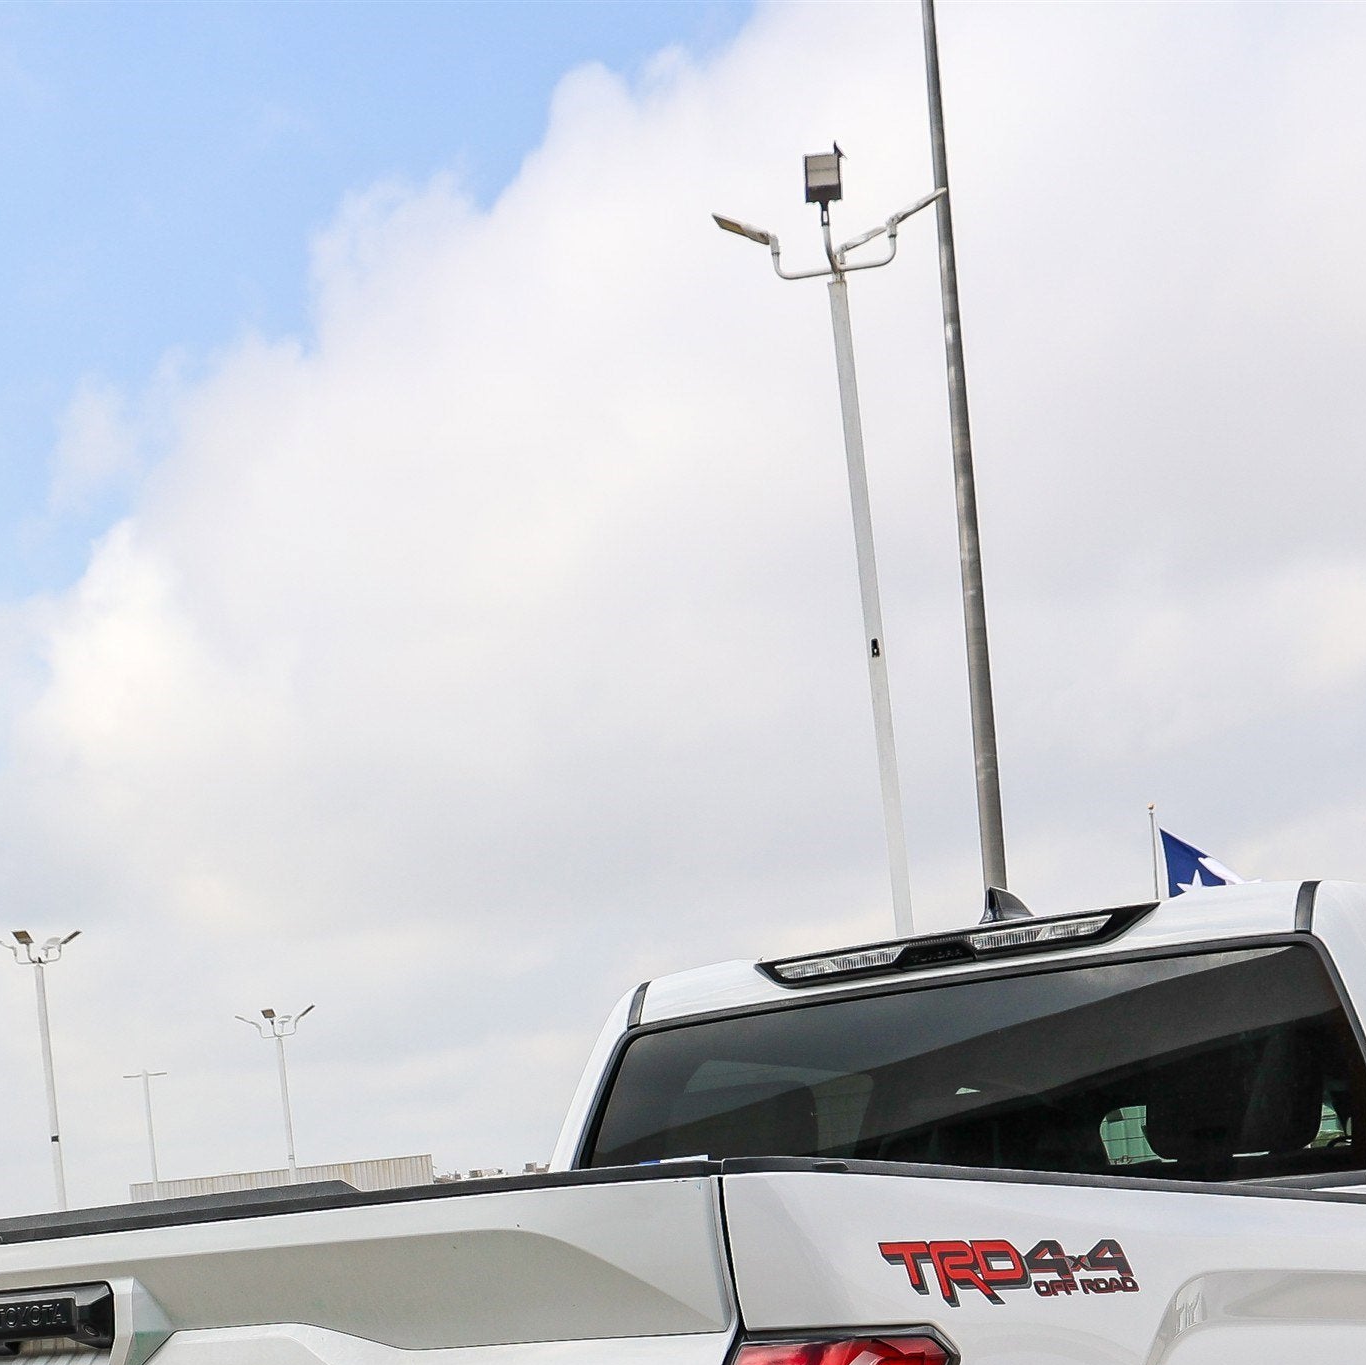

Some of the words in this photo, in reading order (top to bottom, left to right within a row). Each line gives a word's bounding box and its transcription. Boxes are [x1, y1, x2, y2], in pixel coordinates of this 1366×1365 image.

[877, 1239, 1032, 1308] TRD
[1025, 1238, 1136, 1279] 4x4
[1033, 1278, 1079, 1297] OFF
[1078, 1276, 1140, 1296] ROAD
